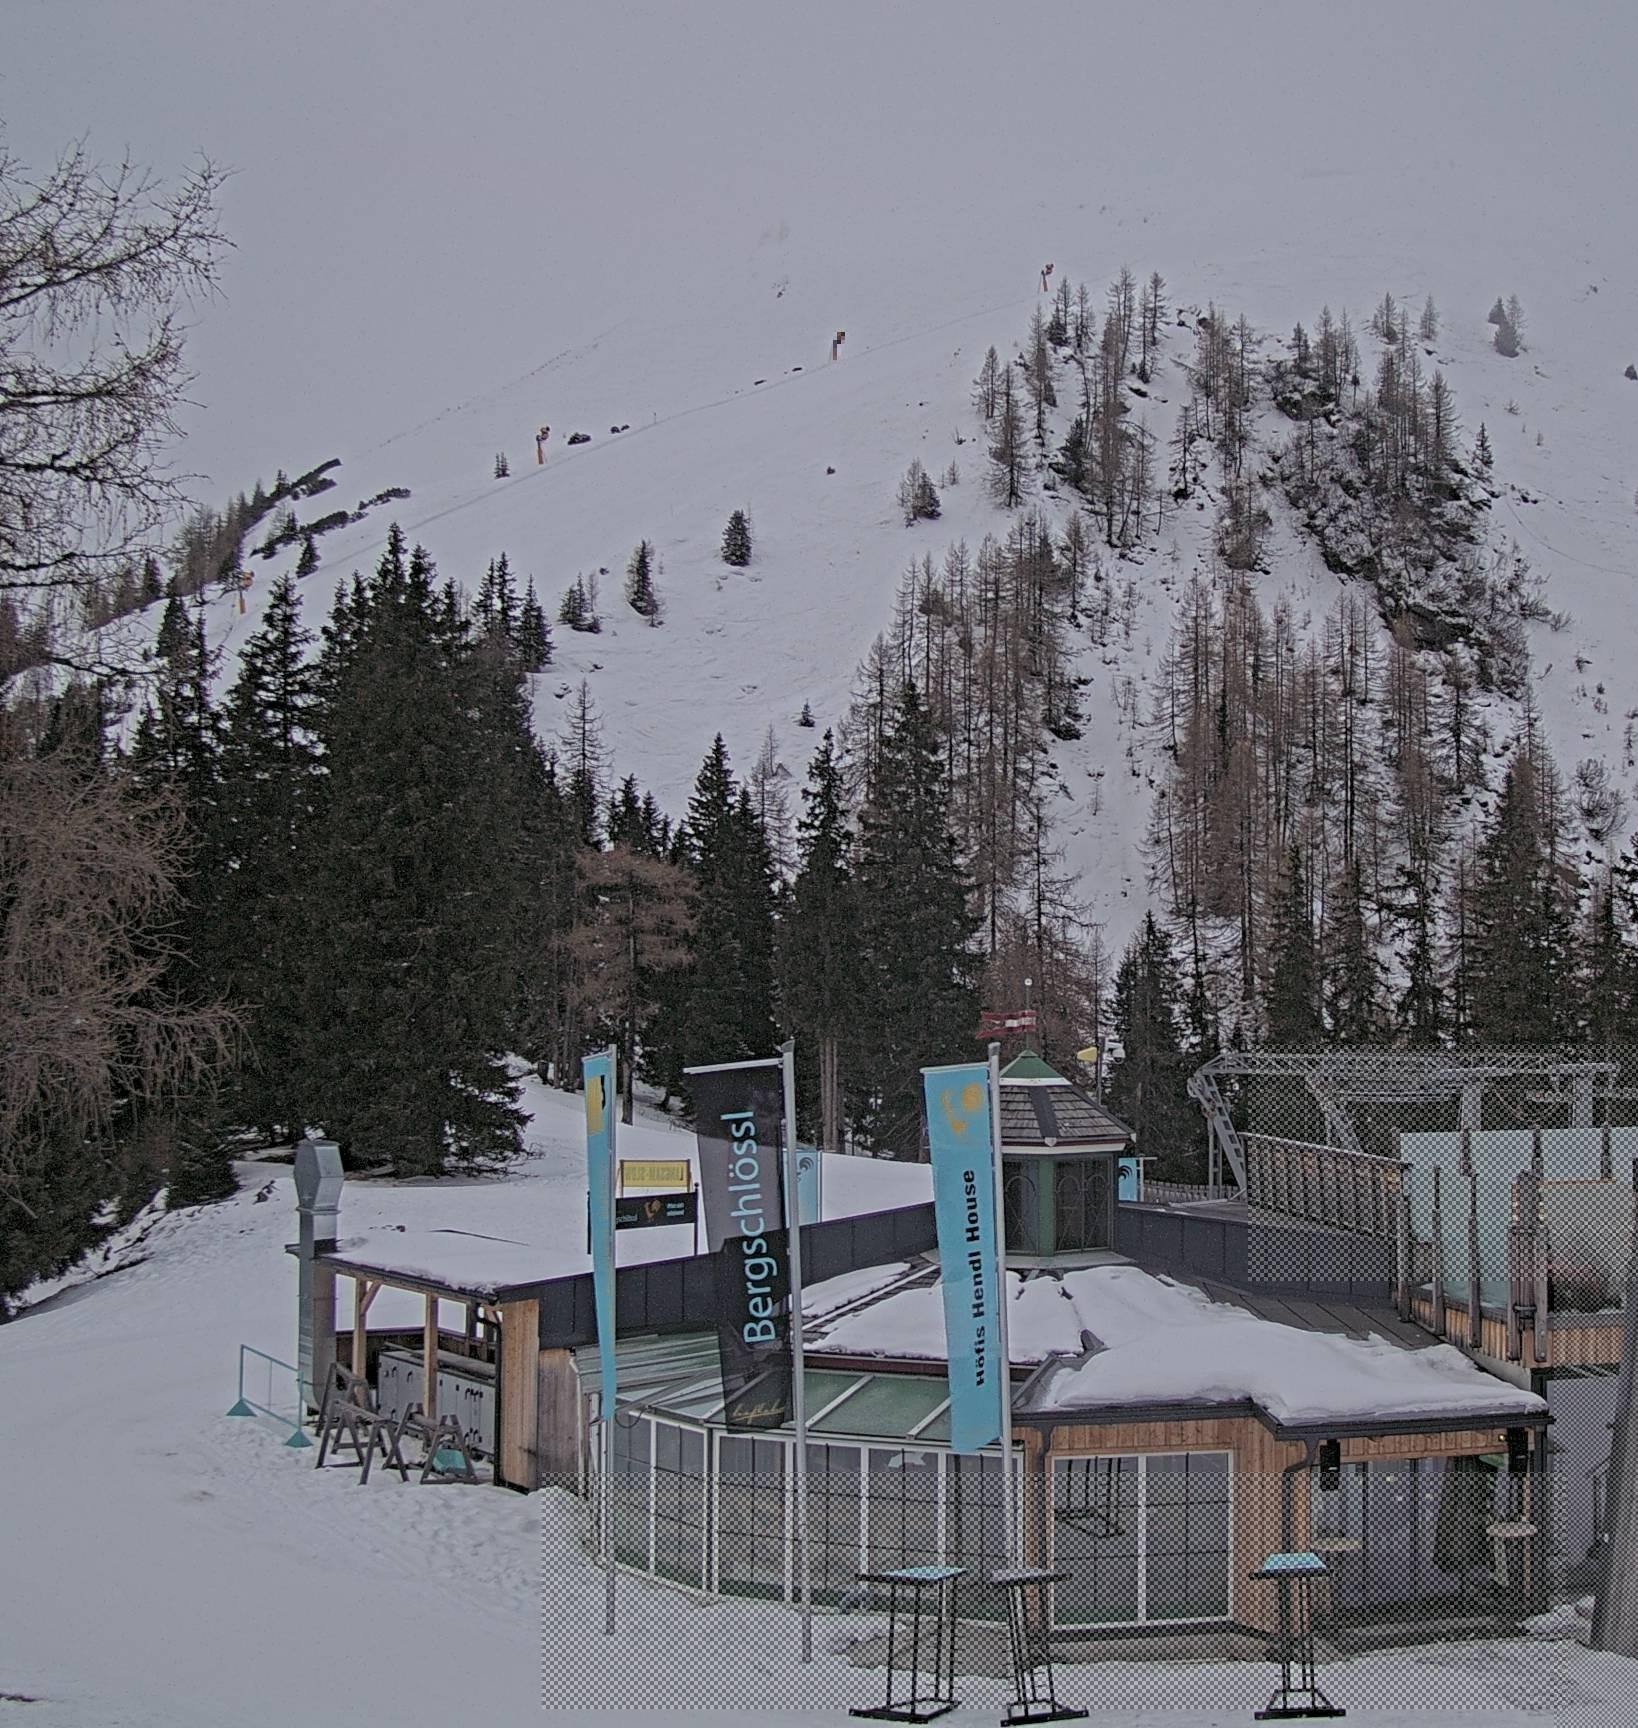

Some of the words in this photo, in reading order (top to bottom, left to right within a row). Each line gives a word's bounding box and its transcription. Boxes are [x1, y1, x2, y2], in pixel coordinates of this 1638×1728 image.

[720, 1111, 777, 1343] Bergschlössl
[963, 1169, 980, 1242] House
[967, 1250, 985, 1318] Hendl
